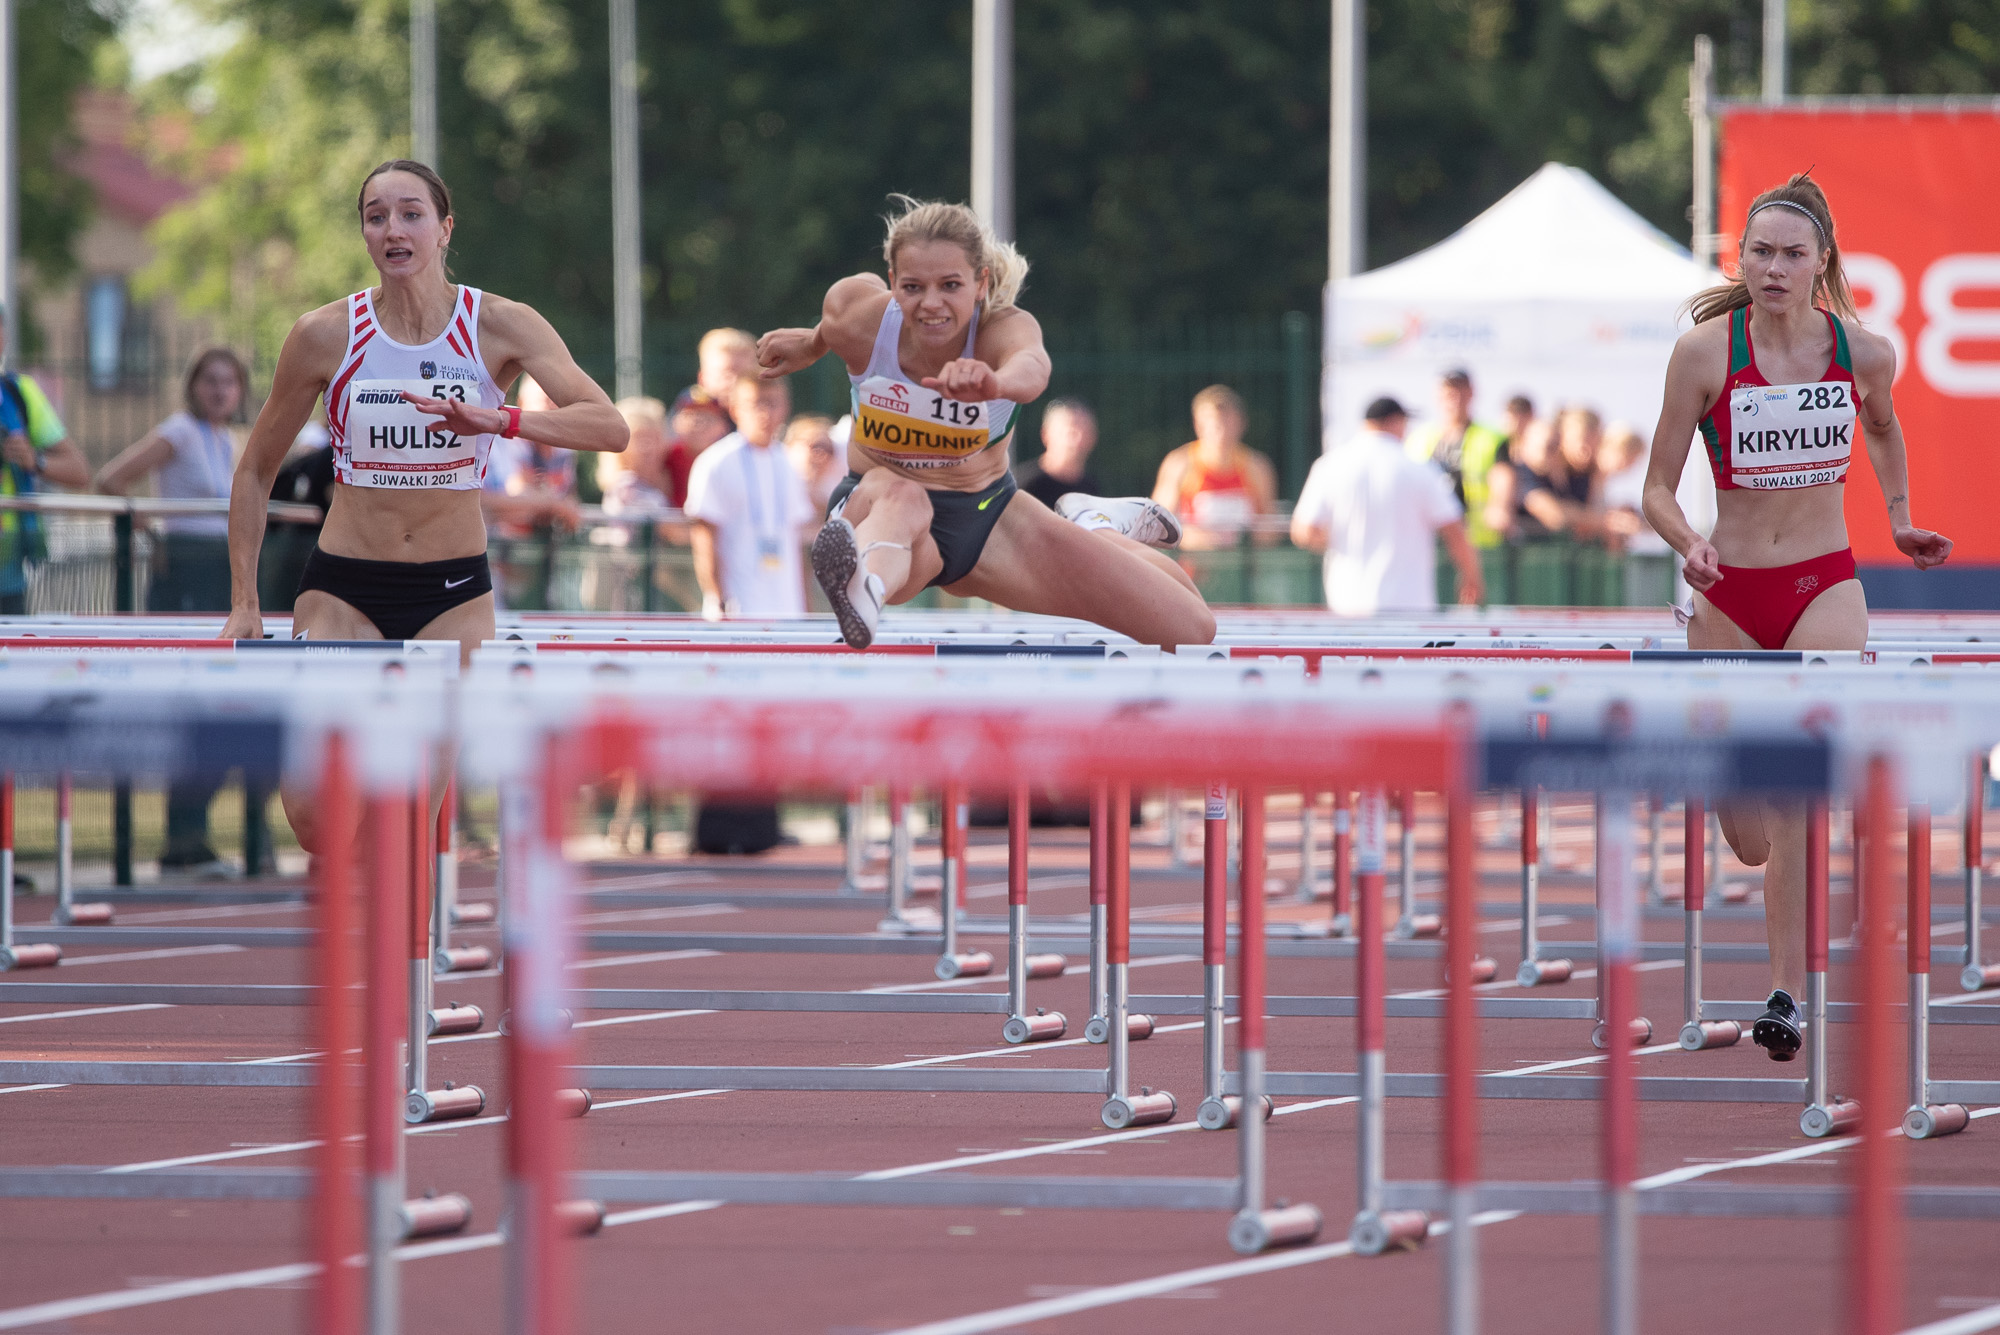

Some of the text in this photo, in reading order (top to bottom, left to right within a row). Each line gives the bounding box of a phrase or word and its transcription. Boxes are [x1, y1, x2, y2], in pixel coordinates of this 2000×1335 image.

[441, 365, 469, 374] MIASTO
[871, 395, 907, 411] ORLEN
[1797, 386, 1848, 411] 282
[931, 397, 980, 425] 119
[370, 426, 462, 449] HULISZ
[863, 416, 981, 450] WOJTUNIK
[1738, 424, 1849, 454] KIRYLUK
[1767, 464, 1814, 472] MISTRZOSTWA
[372, 473, 457, 486] SUWAŁKI 2021
[1753, 471, 1835, 487] SUWAŁKI 2021
